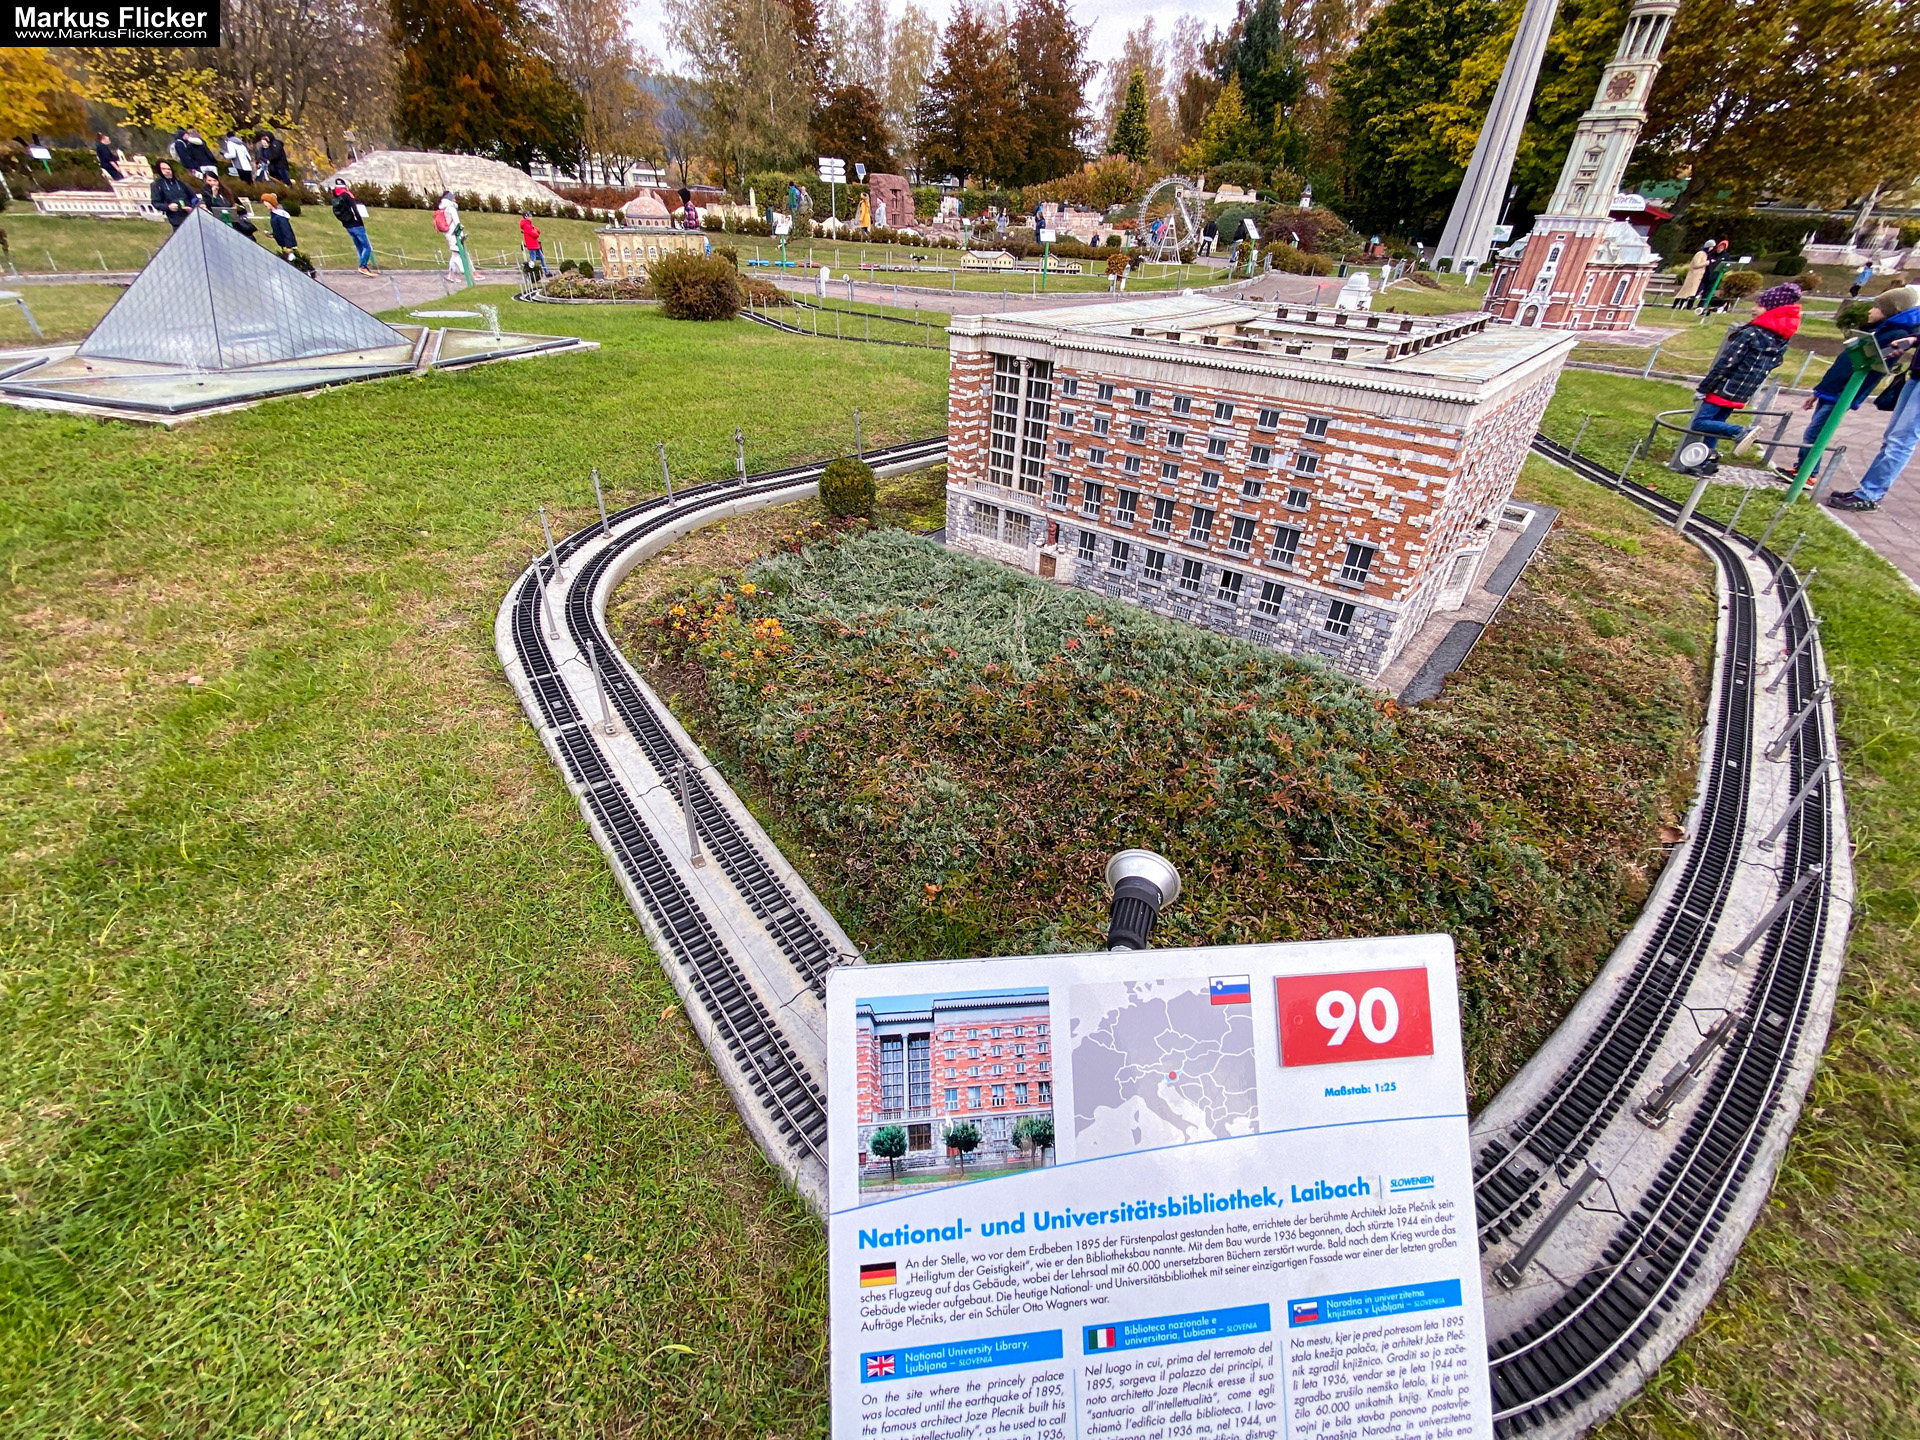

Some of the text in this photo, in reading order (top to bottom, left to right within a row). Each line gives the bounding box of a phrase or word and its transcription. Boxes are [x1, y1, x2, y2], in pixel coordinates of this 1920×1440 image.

[1315, 986, 1399, 1047] 90
[1324, 1082, 1397, 1097] Maßstab: 1:25
[1390, 1175, 1434, 1188] SLOWENIEN
[858, 1175, 1370, 1250] National- und Universitätsbibliothek, Laibach
[904, 1200, 1454, 1269] An der Stelle, wo vor dem Erdbeben 1895 der Fürstenpalast gestanden hatte, errichtete der berühmte Architekt Jože Plečnik sein
[957, 1266, 974, 1278] der
[1035, 1258, 1052, 1269] wie
[1054, 1259, 1064, 1267] er
[1066, 1254, 1084, 1266] den
[1085, 1247, 1150, 1264] Bibliotheksbau
[1152, 1244, 1185, 1256] nannte.
[1188, 1241, 1203, 1252] Mit
[1204, 1239, 1224, 1250] dem
[1225, 1237, 1242, 1247] Bau
[1243, 1232, 1271, 1245] wurde
[1274, 1229, 1297, 1241] 1936
[1298, 1227, 1343, 1240] begonnen,
[1344, 1222, 1365, 1233] doch
[1367, 1220, 1394, 1231] stürzte
[1396, 1215, 1418, 1227] 1944
[1420, 1216, 1433, 1224] ein
[1434, 1213, 1454, 1223] deut-
[859, 1238, 1457, 1318] Gebäude wieder aufgebaut. Die heutige National- und Universitätsbibliothek mit seiner einzigartigen Fassade war einer der letzten großen
[860, 1225, 1456, 1303] sches Flugzeug auf das Gebäude, wobei der Lehrsaal mit 60.000 unersetzbaren Büchern zerstört wurde. Bald nach dem Krieg wurde das
[860, 1296, 1109, 1332] Aufträge Plečniks, der ein Schüler Otto Wagners war.
[1326, 1296, 1362, 1309] Narodna
[1374, 1290, 1425, 1303] univerzitetna
[1326, 1308, 1363, 1319] knjižnica
[1371, 1301, 1404, 1314] Ljubljani
[1124, 1323, 1166, 1335] Biblioteca
[1168, 1315, 1209, 1330] nazionale
[1124, 1332, 1180, 1346] universitaria,
[1182, 1327, 1216, 1338] Lubiana
[1226, 1323, 1257, 1332] SLOVENIA
[1290, 1315, 1464, 1349] Na mestu, kjer je pred potresom leta 1895
[904, 1340, 1029, 1362] National University Library,
[905, 1360, 947, 1375] Ljubljana
[958, 1357, 992, 1366] SLOVENIA
[1084, 1340, 1273, 1377] Nel luogo in cui, prima del terremoto del
[861, 1370, 1065, 1406] On the site where the princely palace
[1087, 1354, 1274, 1391] 1895, sorgeva il palazzo dei principi, il
[861, 1383, 1064, 1421] was located until the earthquake of 1895,
